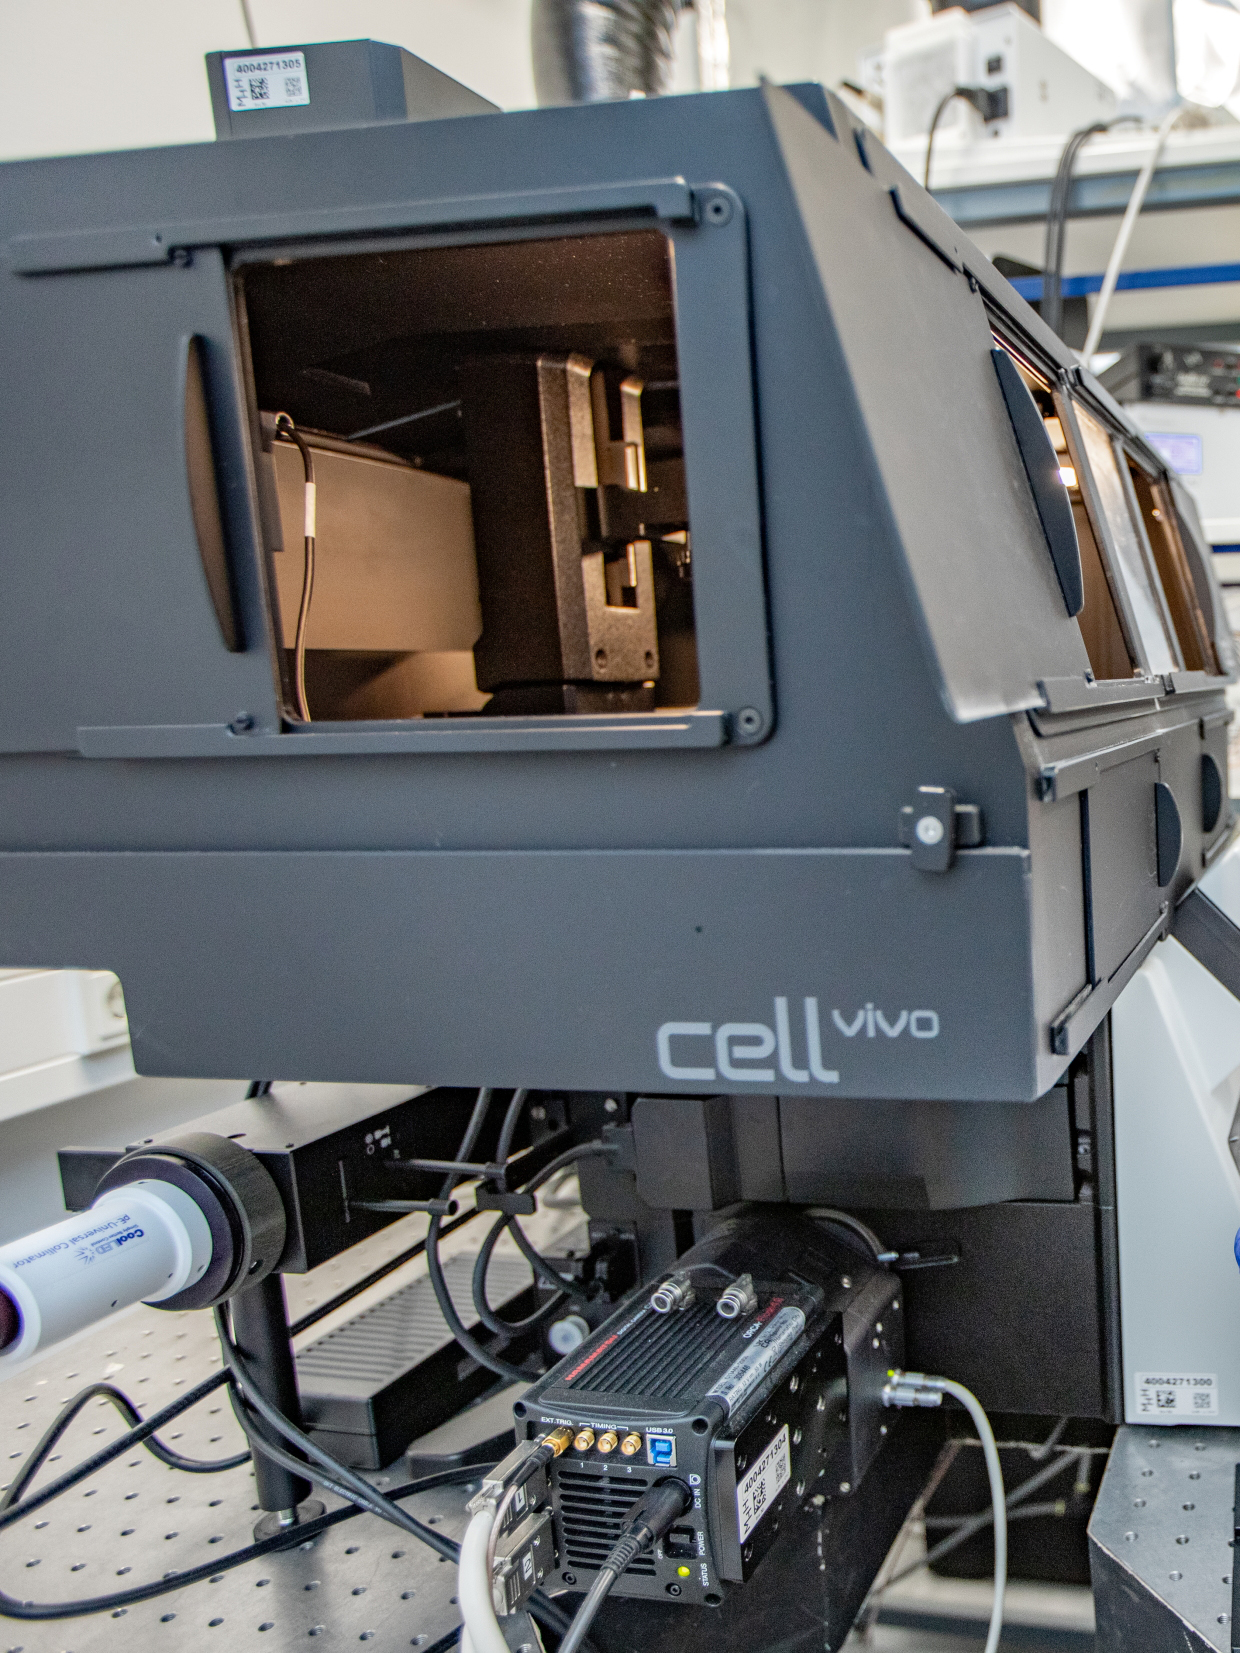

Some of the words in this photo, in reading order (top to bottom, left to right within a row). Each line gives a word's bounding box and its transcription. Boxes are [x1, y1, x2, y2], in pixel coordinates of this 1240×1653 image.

[236, 59, 301, 74] 4004271305
[656, 996, 840, 1083] cell
[831, 1002, 940, 1039] vivo
[69, 1213, 131, 1246] pE-Universal
[13, 1242, 69, 1269] Collimator
[591, 1422, 617, 1430] TIMING
[744, 1432, 786, 1494] 4004271304
[694, 1498, 701, 1509] DC
[697, 1531, 706, 1556] POWER
[700, 1562, 710, 1587] STATUS
